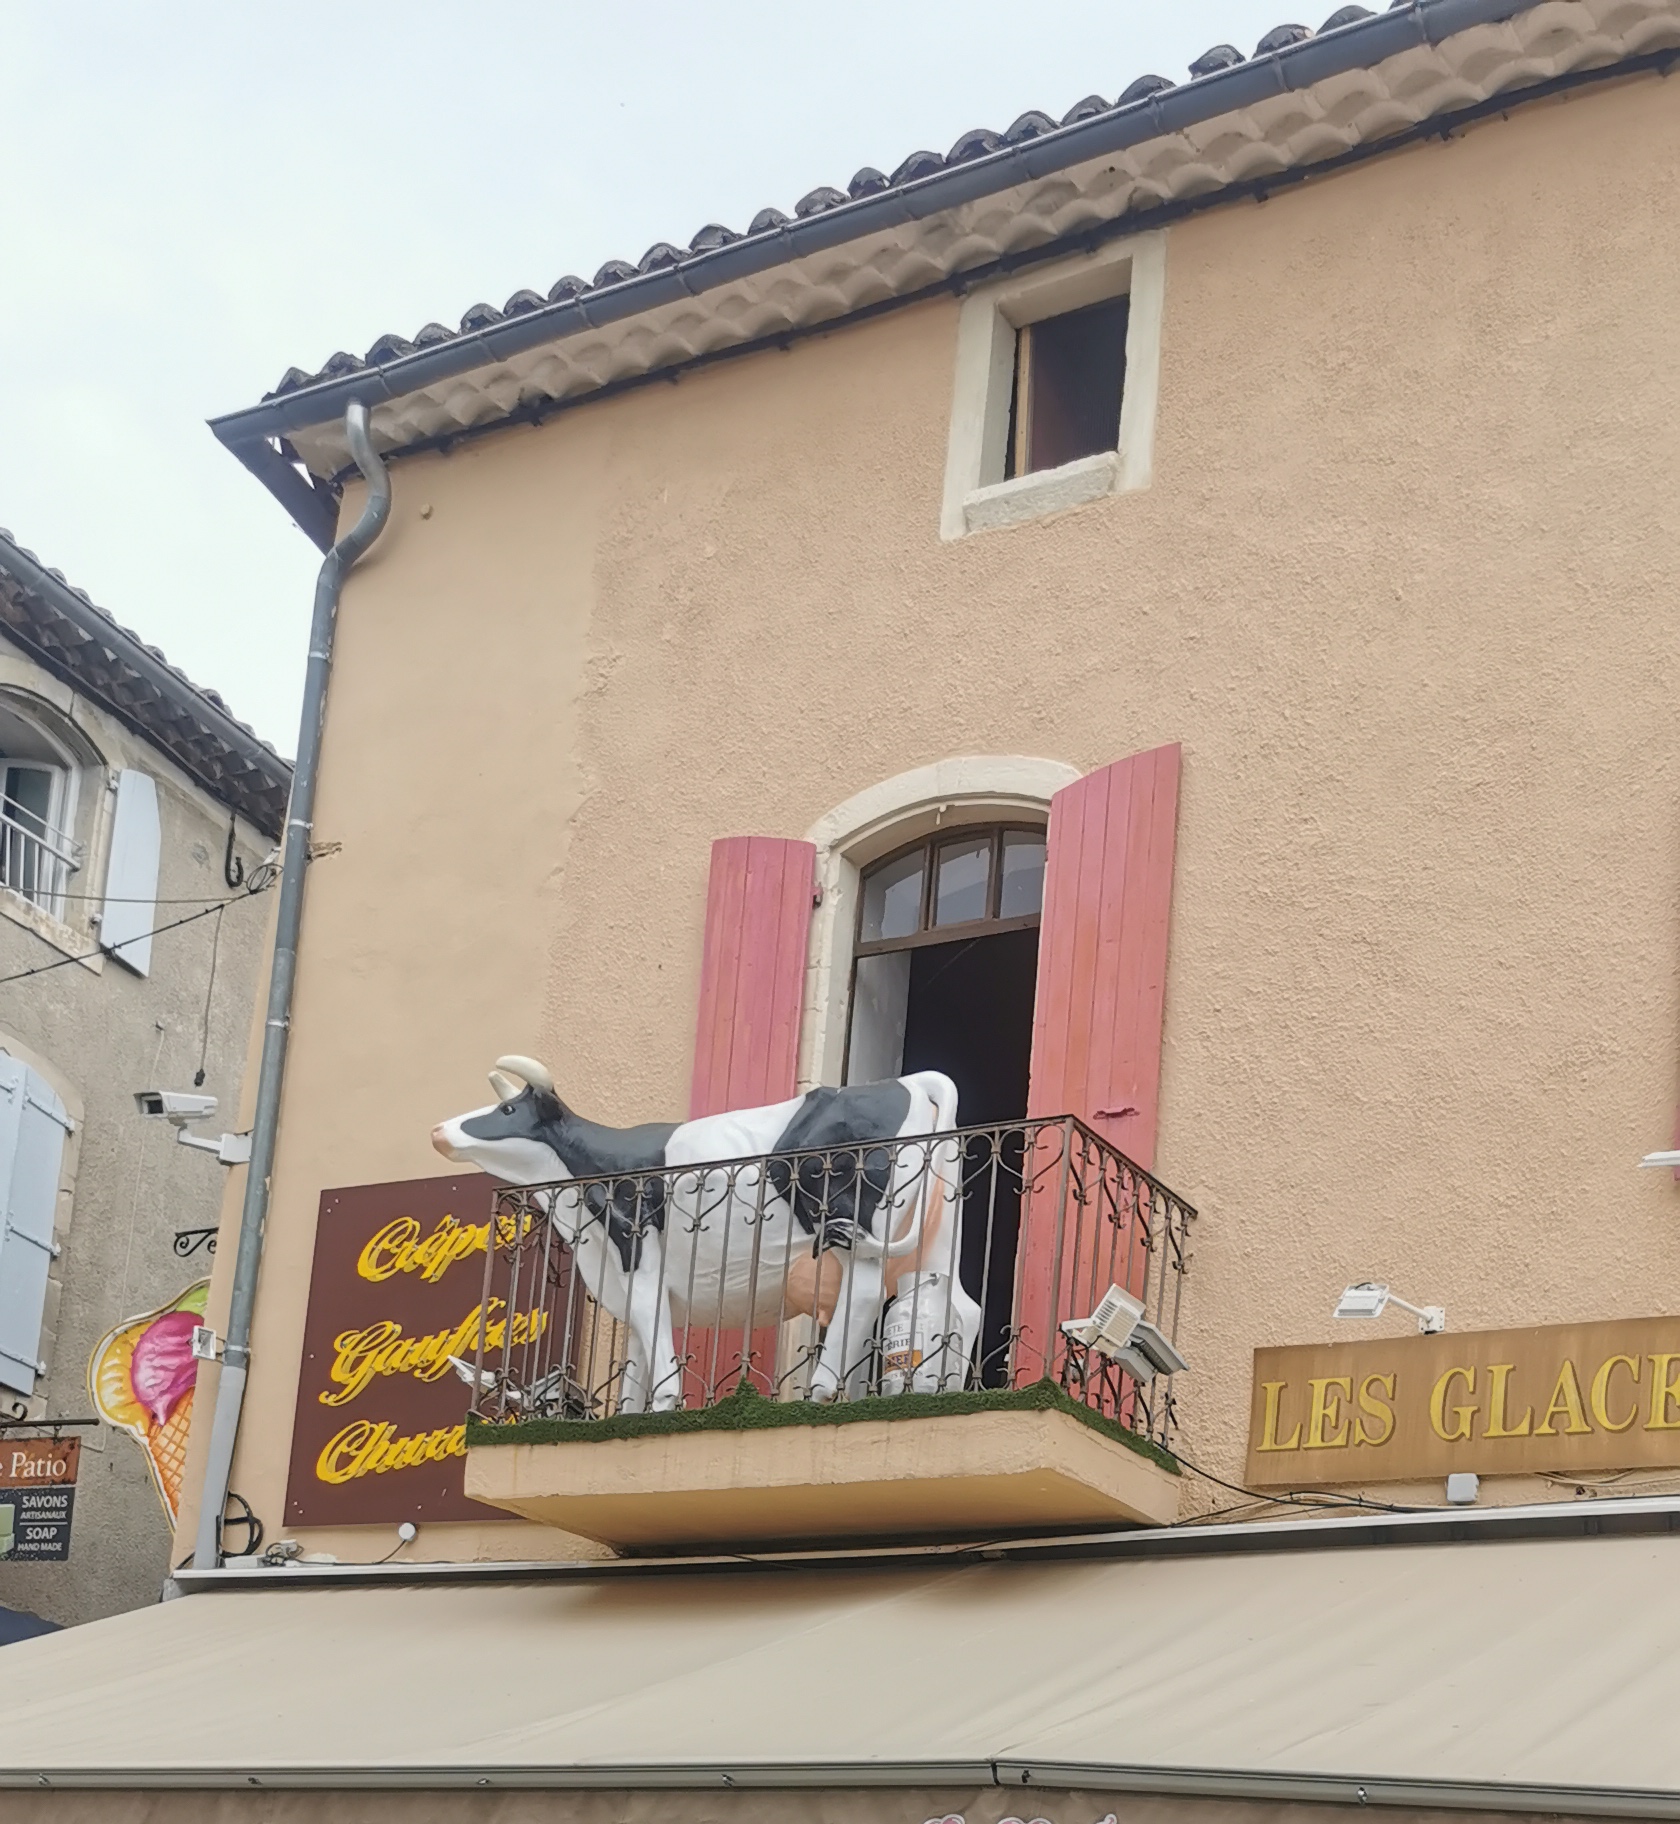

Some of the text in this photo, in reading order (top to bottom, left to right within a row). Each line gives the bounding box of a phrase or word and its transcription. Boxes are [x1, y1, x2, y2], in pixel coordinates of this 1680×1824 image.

[357, 1214, 532, 1283] Crêpes
[319, 1297, 549, 1406] Gaufres
[1256, 1353, 1680, 1452] LES GLACE
[9, 1452, 67, 1478] Patio
[22, 1495, 68, 1509] SAVONS
[20, 1510, 67, 1519] ARTISANAUX
[26, 1527, 57, 1540] SOAP
[17, 1542, 62, 1551] HAND MADE
